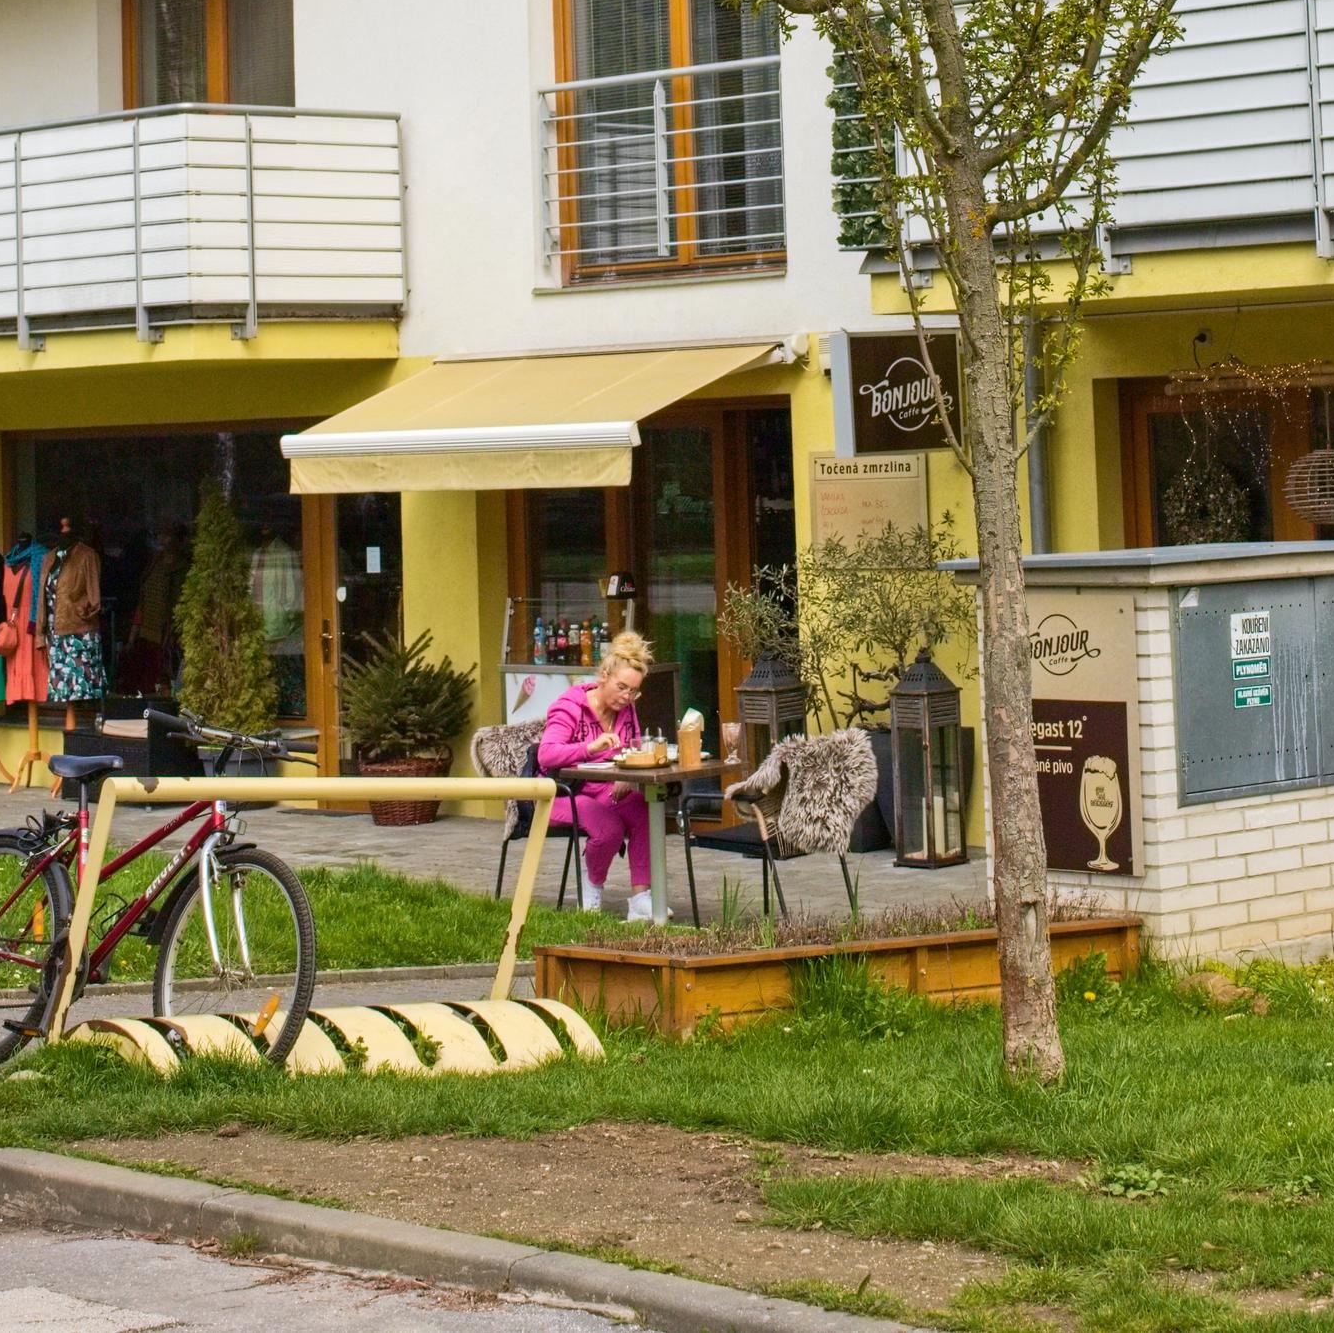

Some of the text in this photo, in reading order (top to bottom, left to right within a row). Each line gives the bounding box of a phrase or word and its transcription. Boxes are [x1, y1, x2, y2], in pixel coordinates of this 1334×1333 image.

[898, 407, 920, 420] Caffe
[820, 460, 912, 475] Točená zmrzlina
[1029, 629, 1101, 660] ONJOUR
[1048, 656, 1069, 666] Caffe
[1029, 720, 1065, 740] egast
[1052, 759, 1073, 775] pivo
